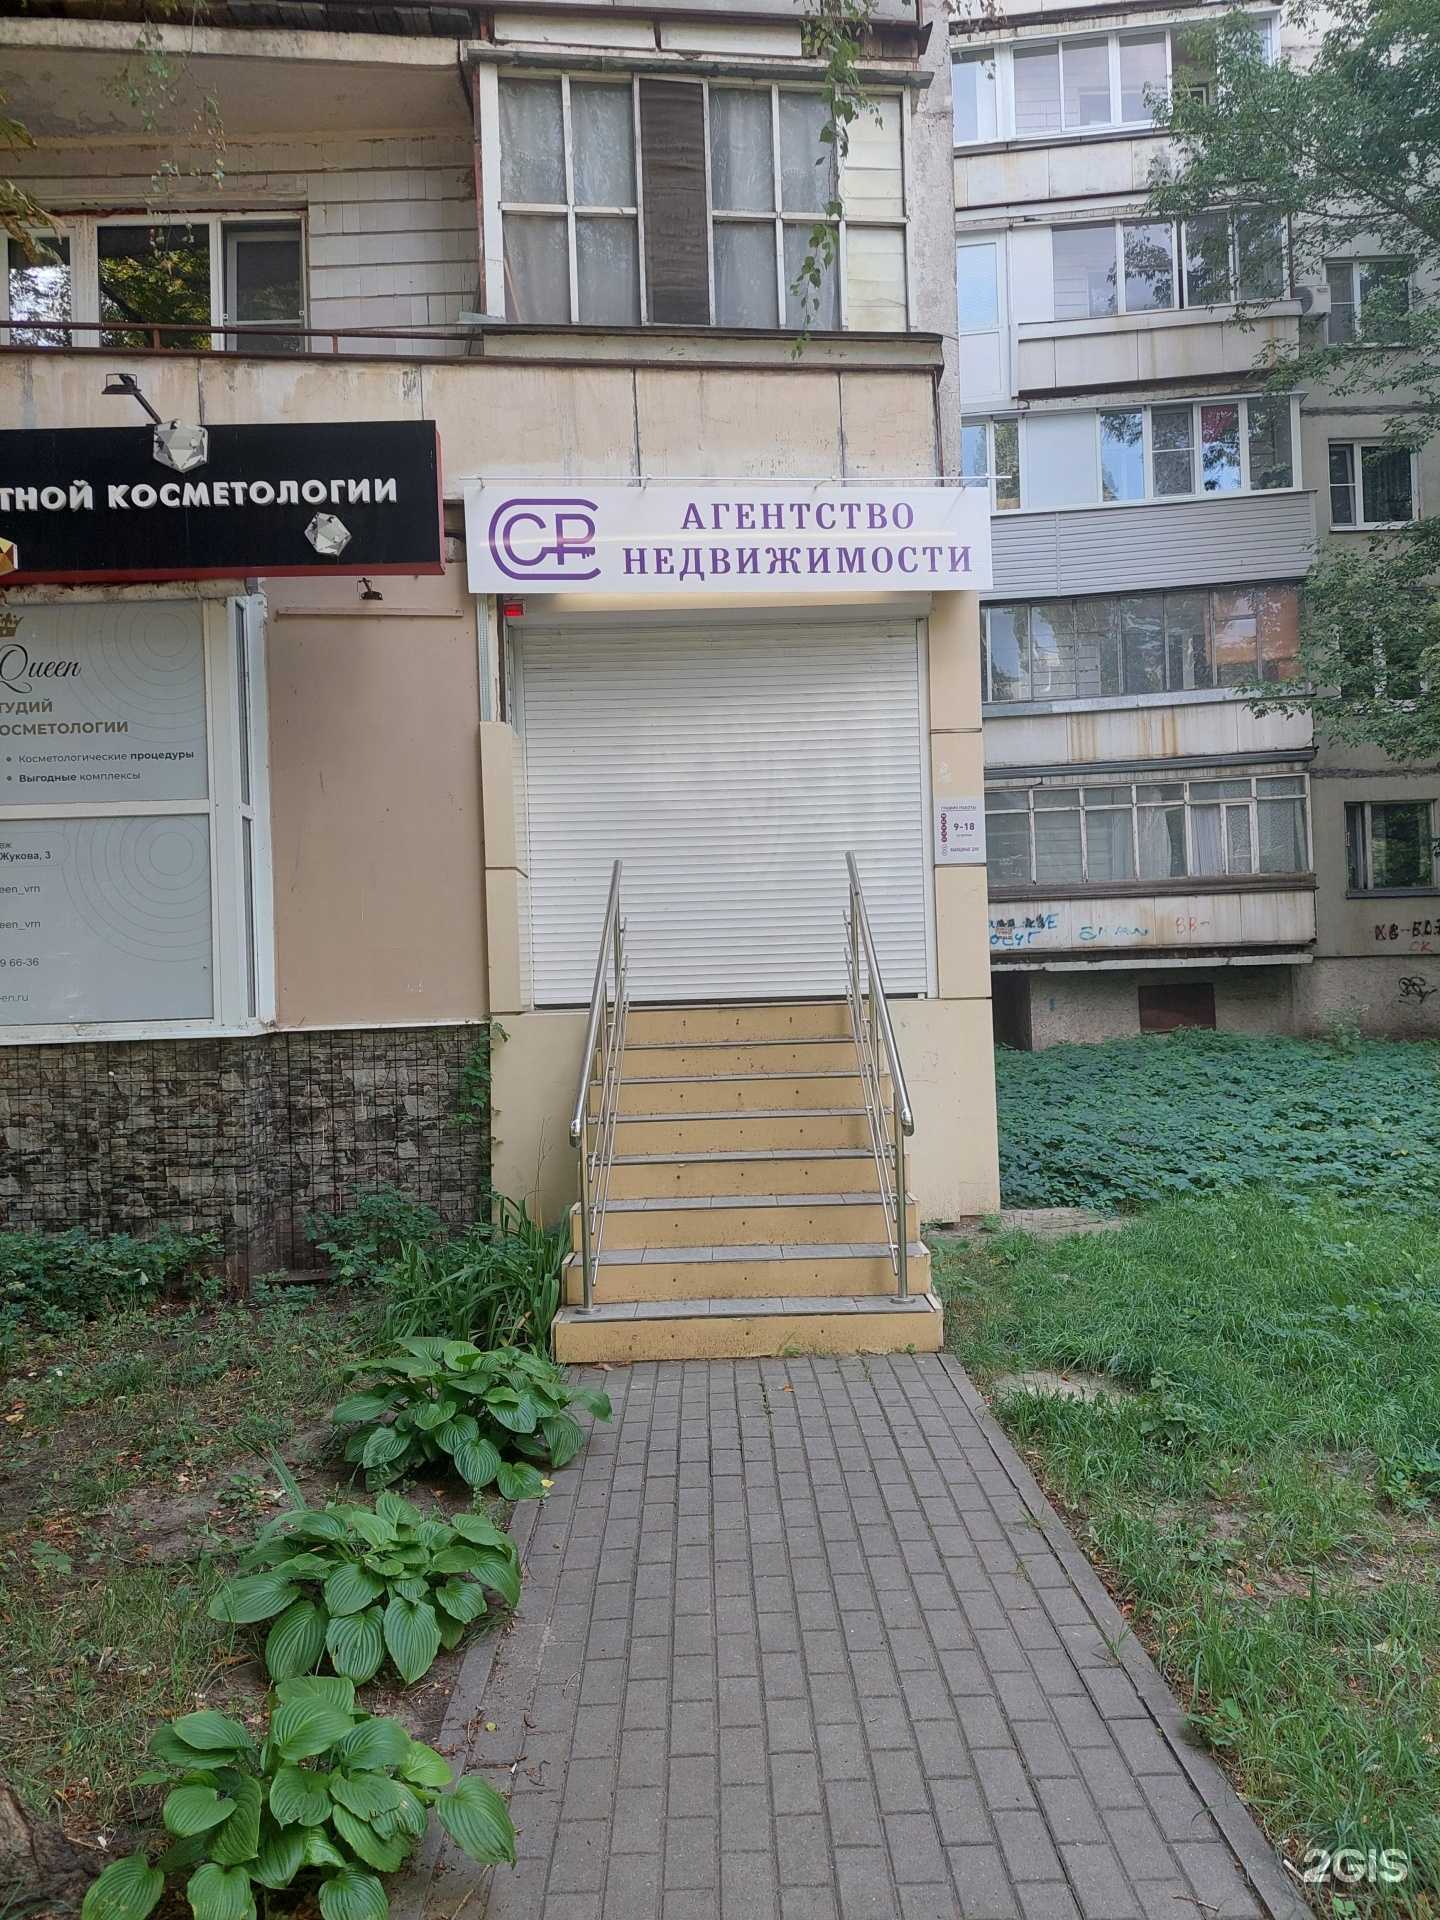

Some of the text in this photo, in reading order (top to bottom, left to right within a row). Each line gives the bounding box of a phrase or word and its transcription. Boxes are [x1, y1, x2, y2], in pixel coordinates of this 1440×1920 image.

[0, 478, 398, 512] ТНОЙ КОСМЕТОЛОГИИ
[680, 501, 915, 531] АГЕНТСТВО
[623, 545, 973, 582] НЕДВИЖИМОСТИ
[0, 644, 81, 693] Queen
[18, 751, 194, 763] Косметологические процедуры
[19, 772, 140, 785] Выгодные комплексы
[44, 850, 51, 859] 3
